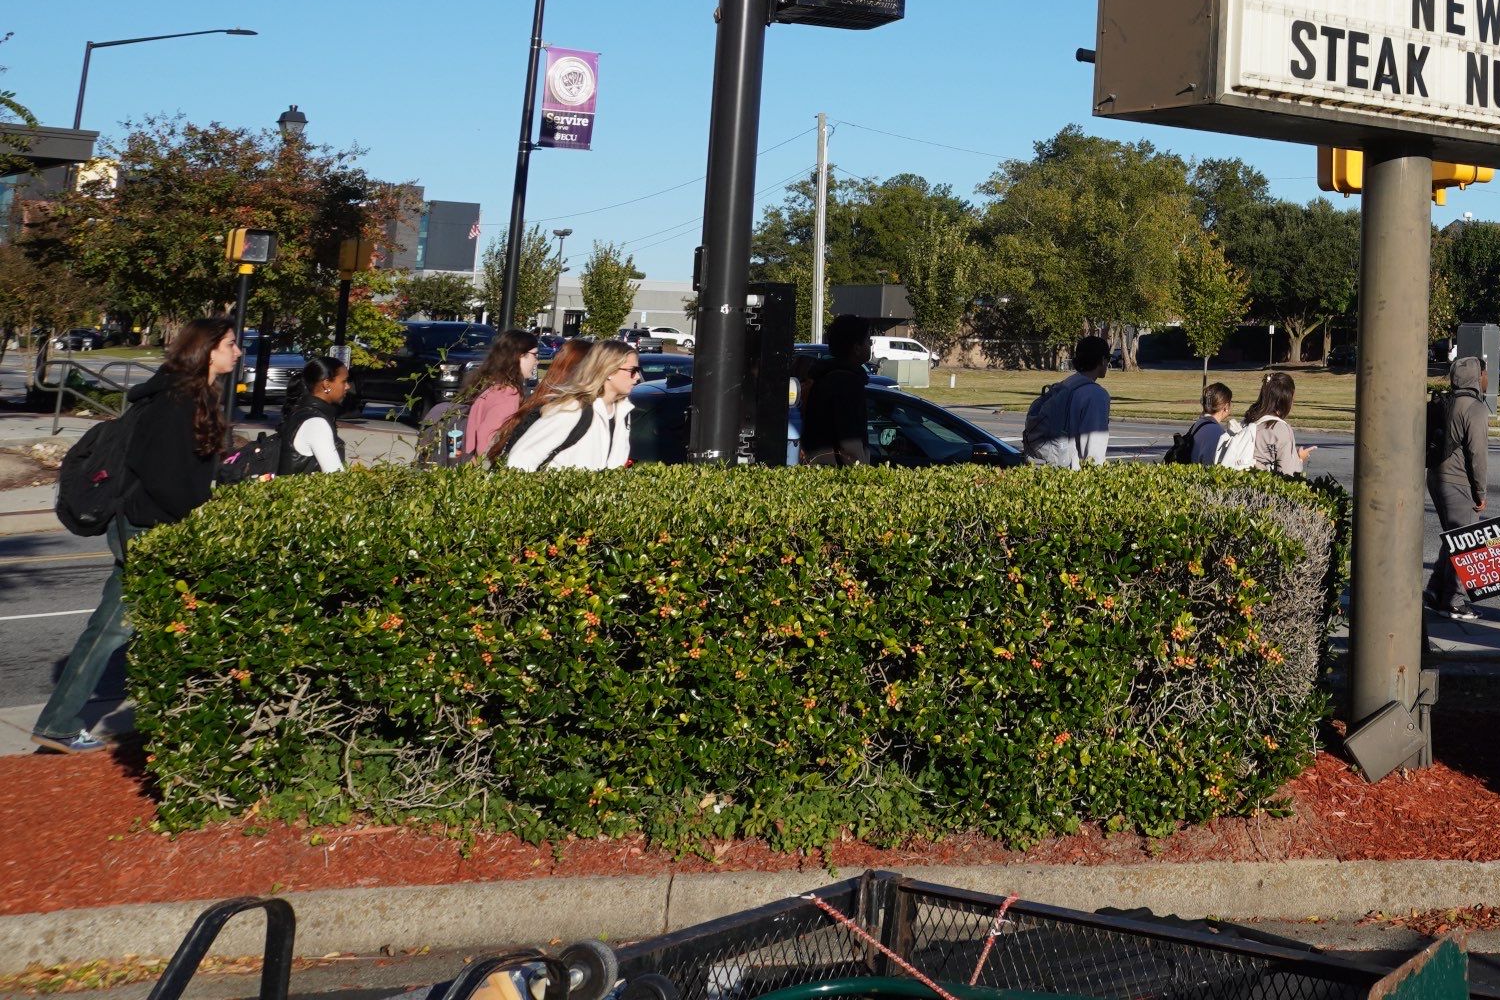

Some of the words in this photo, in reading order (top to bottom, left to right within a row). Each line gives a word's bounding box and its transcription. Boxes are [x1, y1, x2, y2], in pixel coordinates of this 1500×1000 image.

[1290, 19, 1431, 98] STEAK
[546, 113, 589, 126] Servire
[1455, 553, 1472, 567] Call
[1472, 551, 1488, 563] For
[1466, 578, 1476, 589] or
